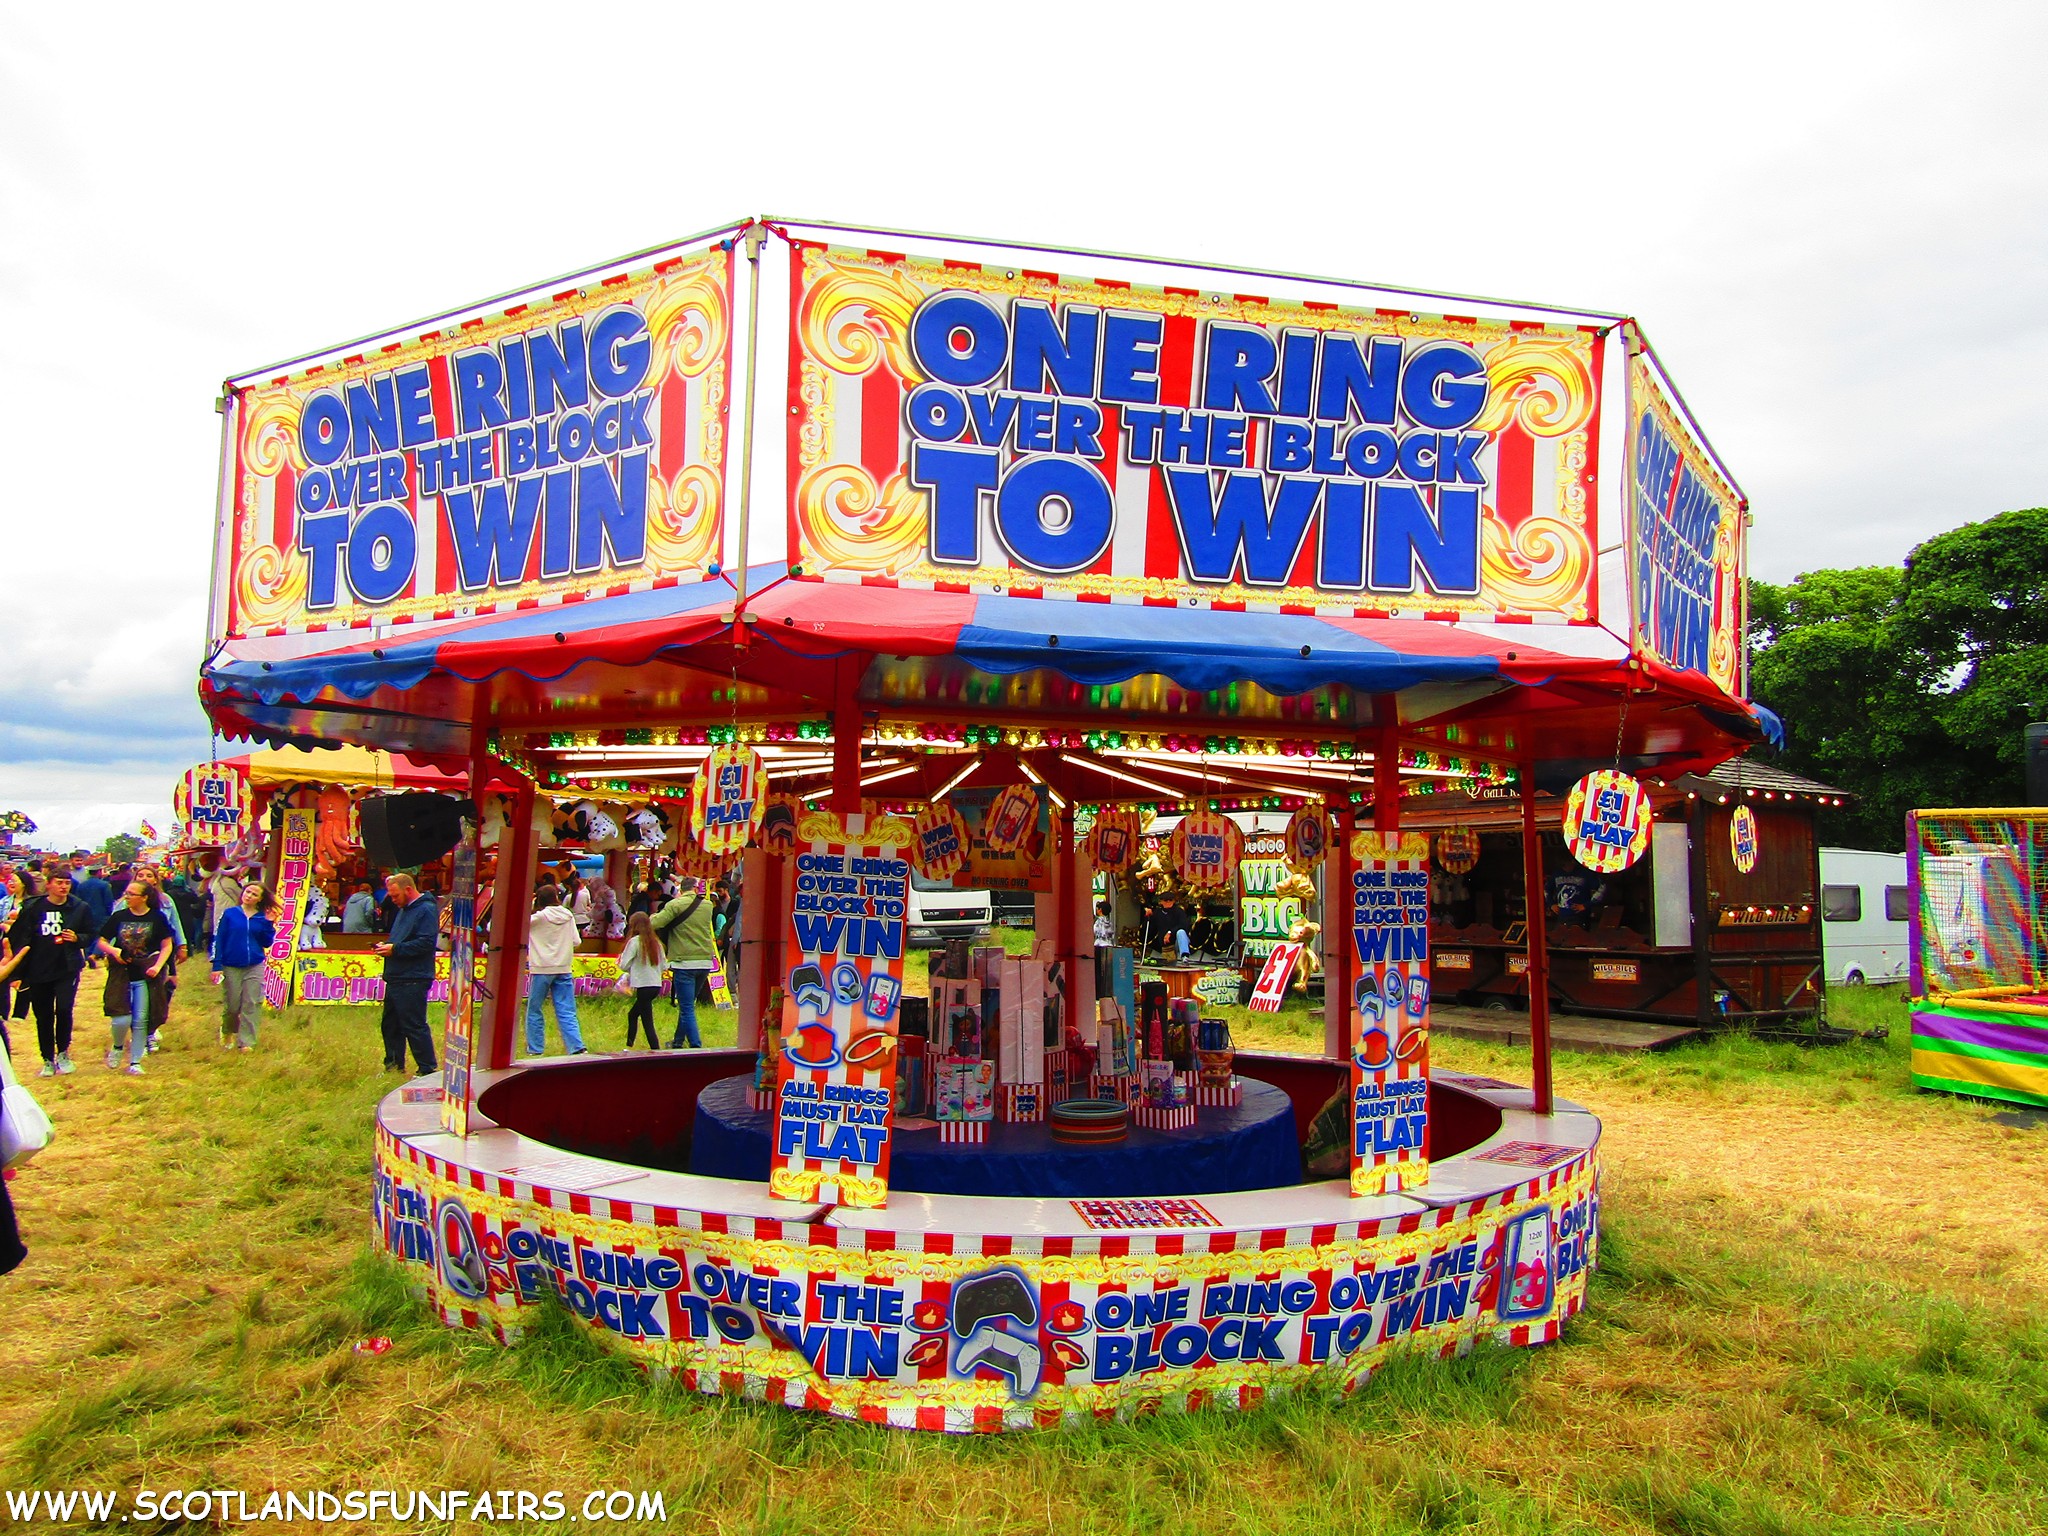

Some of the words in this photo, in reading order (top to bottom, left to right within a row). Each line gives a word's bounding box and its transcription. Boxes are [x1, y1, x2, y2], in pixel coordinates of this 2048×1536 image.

[911, 290, 1164, 404] ONE
[1200, 320, 1489, 429] RING
[301, 362, 429, 465] ONE
[454, 304, 651, 433] RING
[908, 384, 1103, 456] OVER
[1123, 404, 1250, 467] THE
[1269, 422, 1487, 483] BLOCK
[299, 453, 409, 514] OVER
[418, 431, 494, 495] THE
[507, 388, 653, 477] BLOCK
[1637, 407, 1684, 520] ONE
[1672, 458, 1721, 562] RING
[300, 501, 416, 609] TO
[447, 449, 649, 590] WIN
[913, 442, 1116, 573] TO
[1167, 465, 1481, 595] WIN
[1638, 545, 1653, 645] O
[1656, 565, 1711, 680] WIN
[203, 780, 226, 795] £1
[720, 764, 743, 786] £1
[208, 795, 226, 806] TO
[723, 786, 742, 800] TO
[1597, 789, 1624, 810] £1
[192, 807, 242, 824] PLAY
[705, 799, 755, 828] PLAY
[1601, 811, 1621, 824] TO
[286, 838, 310, 856] the
[922, 822, 954, 847] WIN
[1187, 833, 1223, 849] WIN
[1579, 821, 1637, 849] PLAY
[924, 837, 960, 864] £100
[1189, 850, 1222, 865] £50
[797, 854, 845, 873] ONE
[850, 857, 909, 878] RING
[1352, 870, 1386, 888] ONE
[1390, 870, 1429, 888] RING
[797, 875, 858, 894] OVER
[864, 877, 905, 898] THE
[1354, 888, 1398, 907] OVER
[1400, 888, 1428, 906] THE
[46, 911, 62, 924] JU
[270, 860, 308, 960] prize
[795, 893, 868, 916] BLOCK
[873, 898, 904, 918] TO
[1242, 897, 1302, 936] BIG
[1354, 906, 1404, 926] BLOCK
[1407, 906, 1428, 925] TO
[1734, 911, 1763, 924] WILD
[1766, 911, 1798, 923] BILLS
[793, 912, 903, 960] WIN
[1352, 925, 1428, 964] WIN
[297, 957, 318, 972] it's
[1256, 944, 1300, 995] £1
[1436, 953, 1451, 963] WILD
[1509, 957, 1528, 965] SHOO
[1593, 963, 1614, 973] WILD
[1615, 964, 1637, 973] BILLS
[303, 972, 346, 1001] the
[350, 974, 387, 1003] pri
[574, 974, 615, 997] rize
[1197, 975, 1242, 992] GAMES
[1216, 986, 1228, 995] TO
[1207, 993, 1240, 1006] PLAY
[1249, 996, 1281, 1012] ONLY
[781, 1079, 819, 1100] ALL
[823, 1083, 891, 1106] RINGS
[1354, 1082, 1381, 1102] ALL
[1383, 1076, 1427, 1099] RINGS
[781, 1099, 842, 1122] MUST
[846, 1105, 889, 1126] LAY
[1354, 1099, 1398, 1121] MUST
[1399, 1094, 1427, 1114] LAY
[778, 1118, 889, 1165] FLAT
[1355, 1112, 1428, 1157] FLAT
[396, 1187, 429, 1224] THE
[1558, 1199, 1588, 1239] ONE
[387, 1209, 435, 1268] WIN
[1528, 1230, 1543, 1241] 12:00
[507, 1228, 573, 1274] ONE
[581, 1246, 682, 1291] RING
[693, 1262, 801, 1318] OVER
[817, 1281, 904, 1326] THE
[1094, 1286, 1190, 1332] ONE
[1204, 1278, 1317, 1319] RING
[1329, 1264, 1421, 1311] OVER
[1424, 1241, 1478, 1284] THE
[515, 1262, 666, 1338] BLOCK
[680, 1292, 756, 1341] TO
[764, 1315, 901, 1380] WIN
[1091, 1315, 1290, 1383] BLOCK
[1306, 1310, 1373, 1360] TO
[1384, 1277, 1472, 1339] WIN
